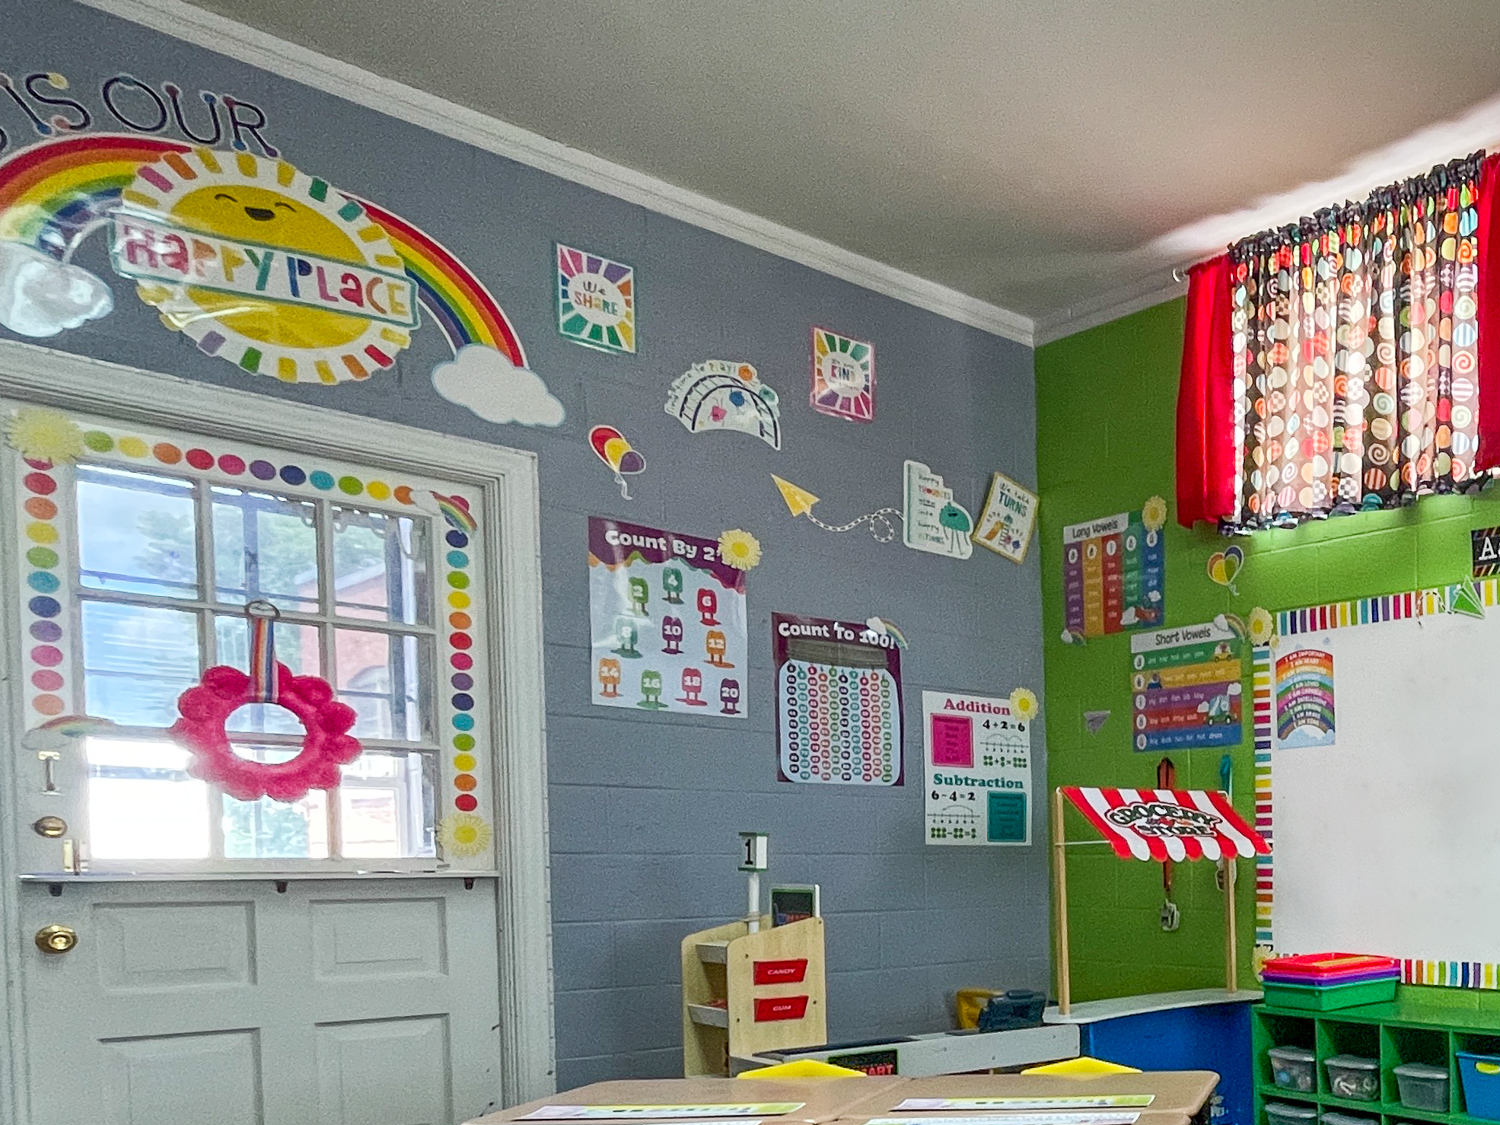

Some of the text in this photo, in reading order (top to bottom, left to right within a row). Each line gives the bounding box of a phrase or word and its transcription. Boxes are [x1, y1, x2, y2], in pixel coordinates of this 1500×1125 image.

[102, 74, 279, 157] OUR
[583, 281, 606, 296] We
[999, 492, 1028, 518] TURNS
[1072, 520, 1119, 539] Long Vowels
[605, 530, 721, 561] Count By 2'
[668, 575, 678, 586] 4
[702, 596, 712, 607] 6
[664, 625, 682, 636] 10
[778, 622, 895, 649] Count To 100!
[1155, 627, 1212, 646] Short Vowels
[708, 638, 725, 649] 12
[684, 676, 701, 686] 18
[722, 687, 739, 699] 20
[943, 698, 1011, 716] Addition
[933, 773, 1024, 789] Subtraction
[1109, 803, 1223, 825] GROCERY
[1137, 825, 1215, 837] STORE
[744, 838, 754, 865] 1
[767, 967, 796, 976] CANDY
